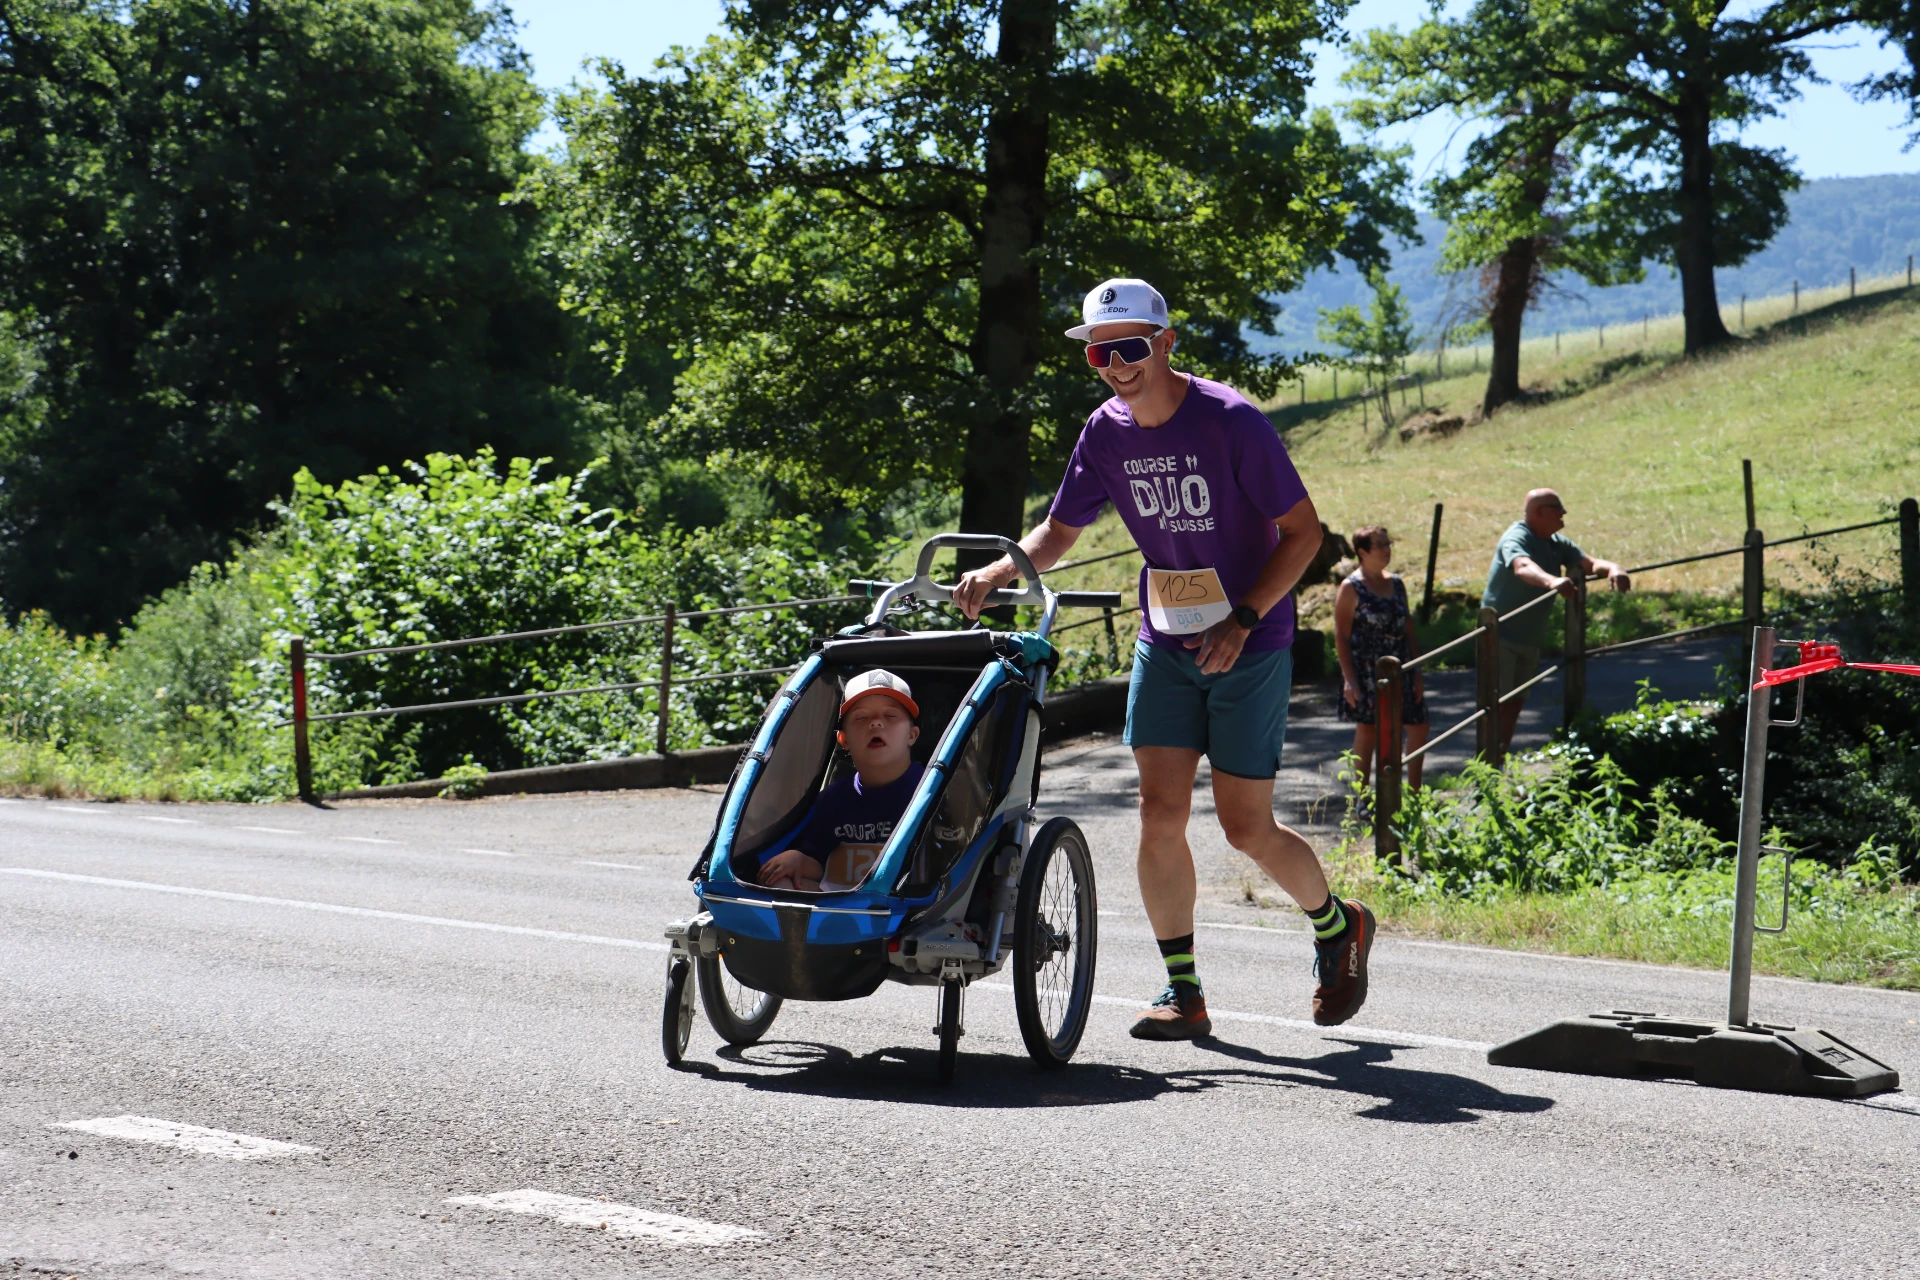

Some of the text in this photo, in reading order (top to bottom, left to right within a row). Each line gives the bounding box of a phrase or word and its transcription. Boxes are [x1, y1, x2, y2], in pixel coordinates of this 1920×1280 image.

[1123, 455, 1178, 475] COURSE
[1129, 474, 1211, 517] DUO
[1169, 517, 1215, 533] SUISSE
[1161, 575, 1208, 602] 125
[1176, 612, 1204, 625] DUO
[834, 821, 891, 840] COURSE
[1348, 941, 1357, 977] HOKA
